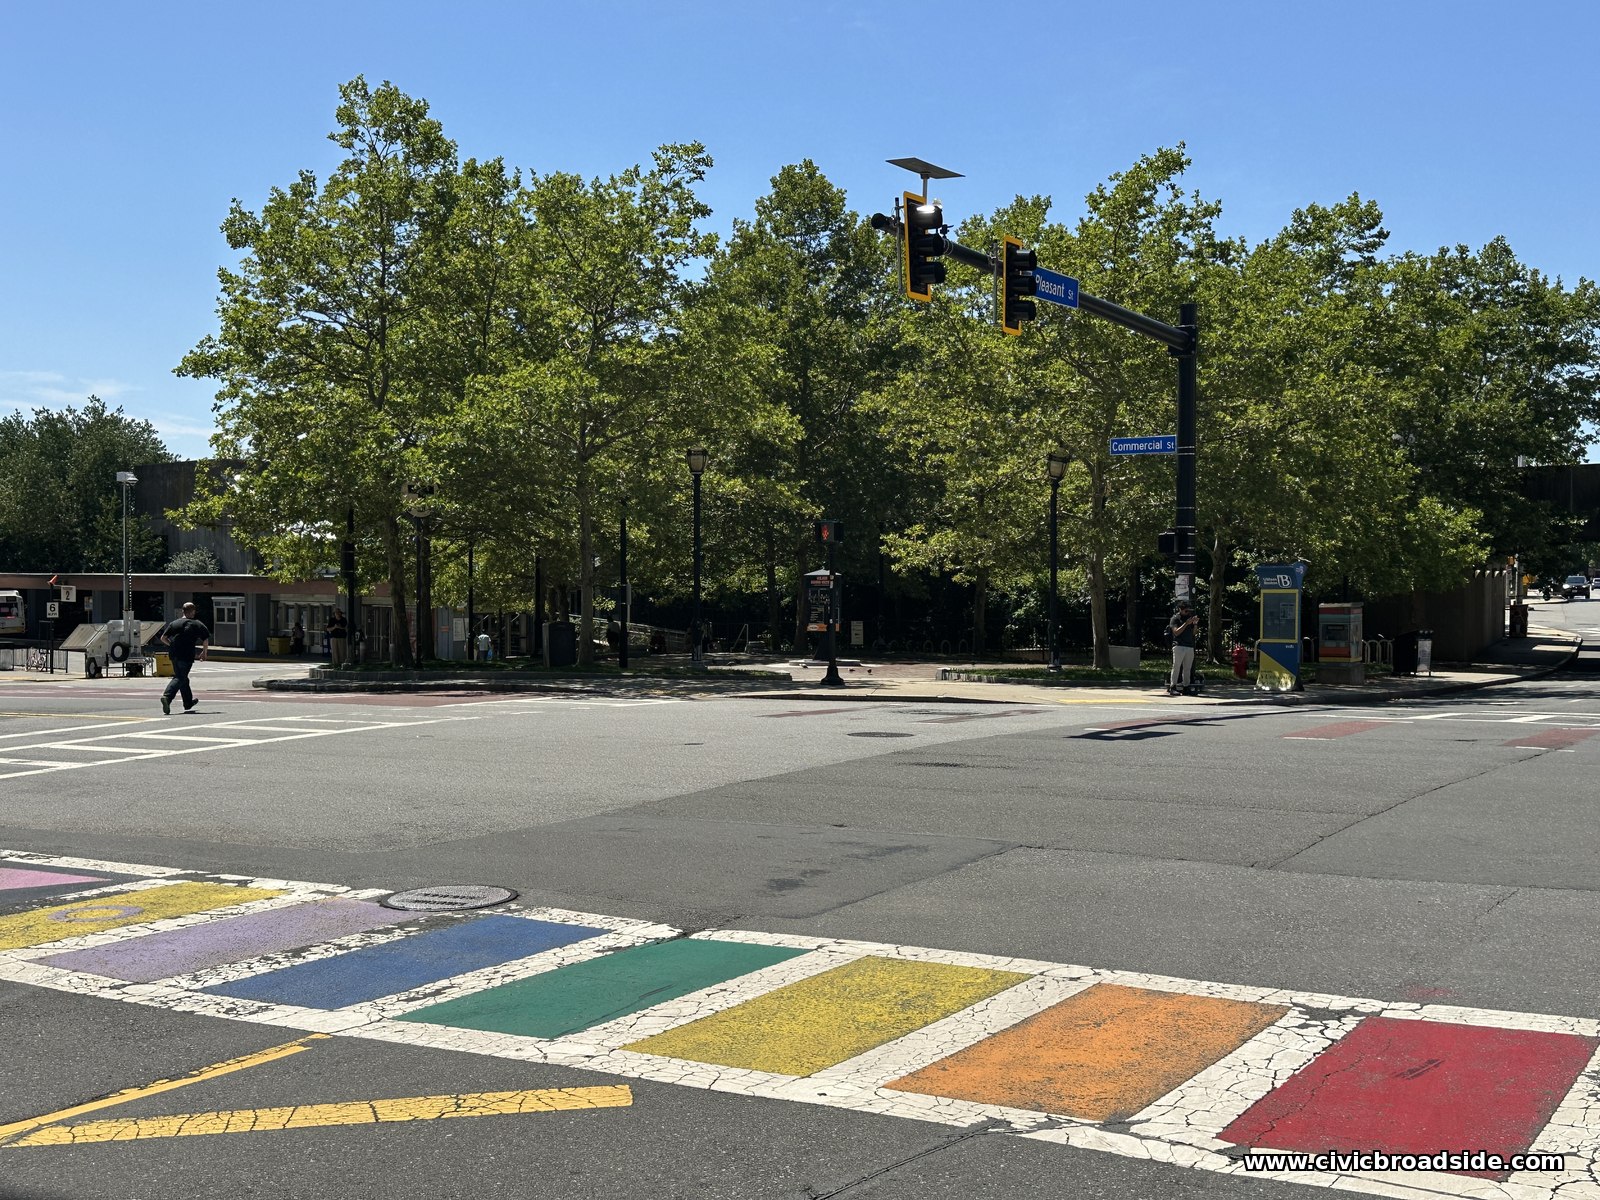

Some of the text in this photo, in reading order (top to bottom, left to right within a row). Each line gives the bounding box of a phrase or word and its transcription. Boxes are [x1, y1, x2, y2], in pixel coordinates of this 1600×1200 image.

[1035, 274, 1074, 300] Pleasant St
[1112, 440, 1174, 451] Commercial St
[65, 591, 70, 600] 2
[50, 603, 56, 612] 6
